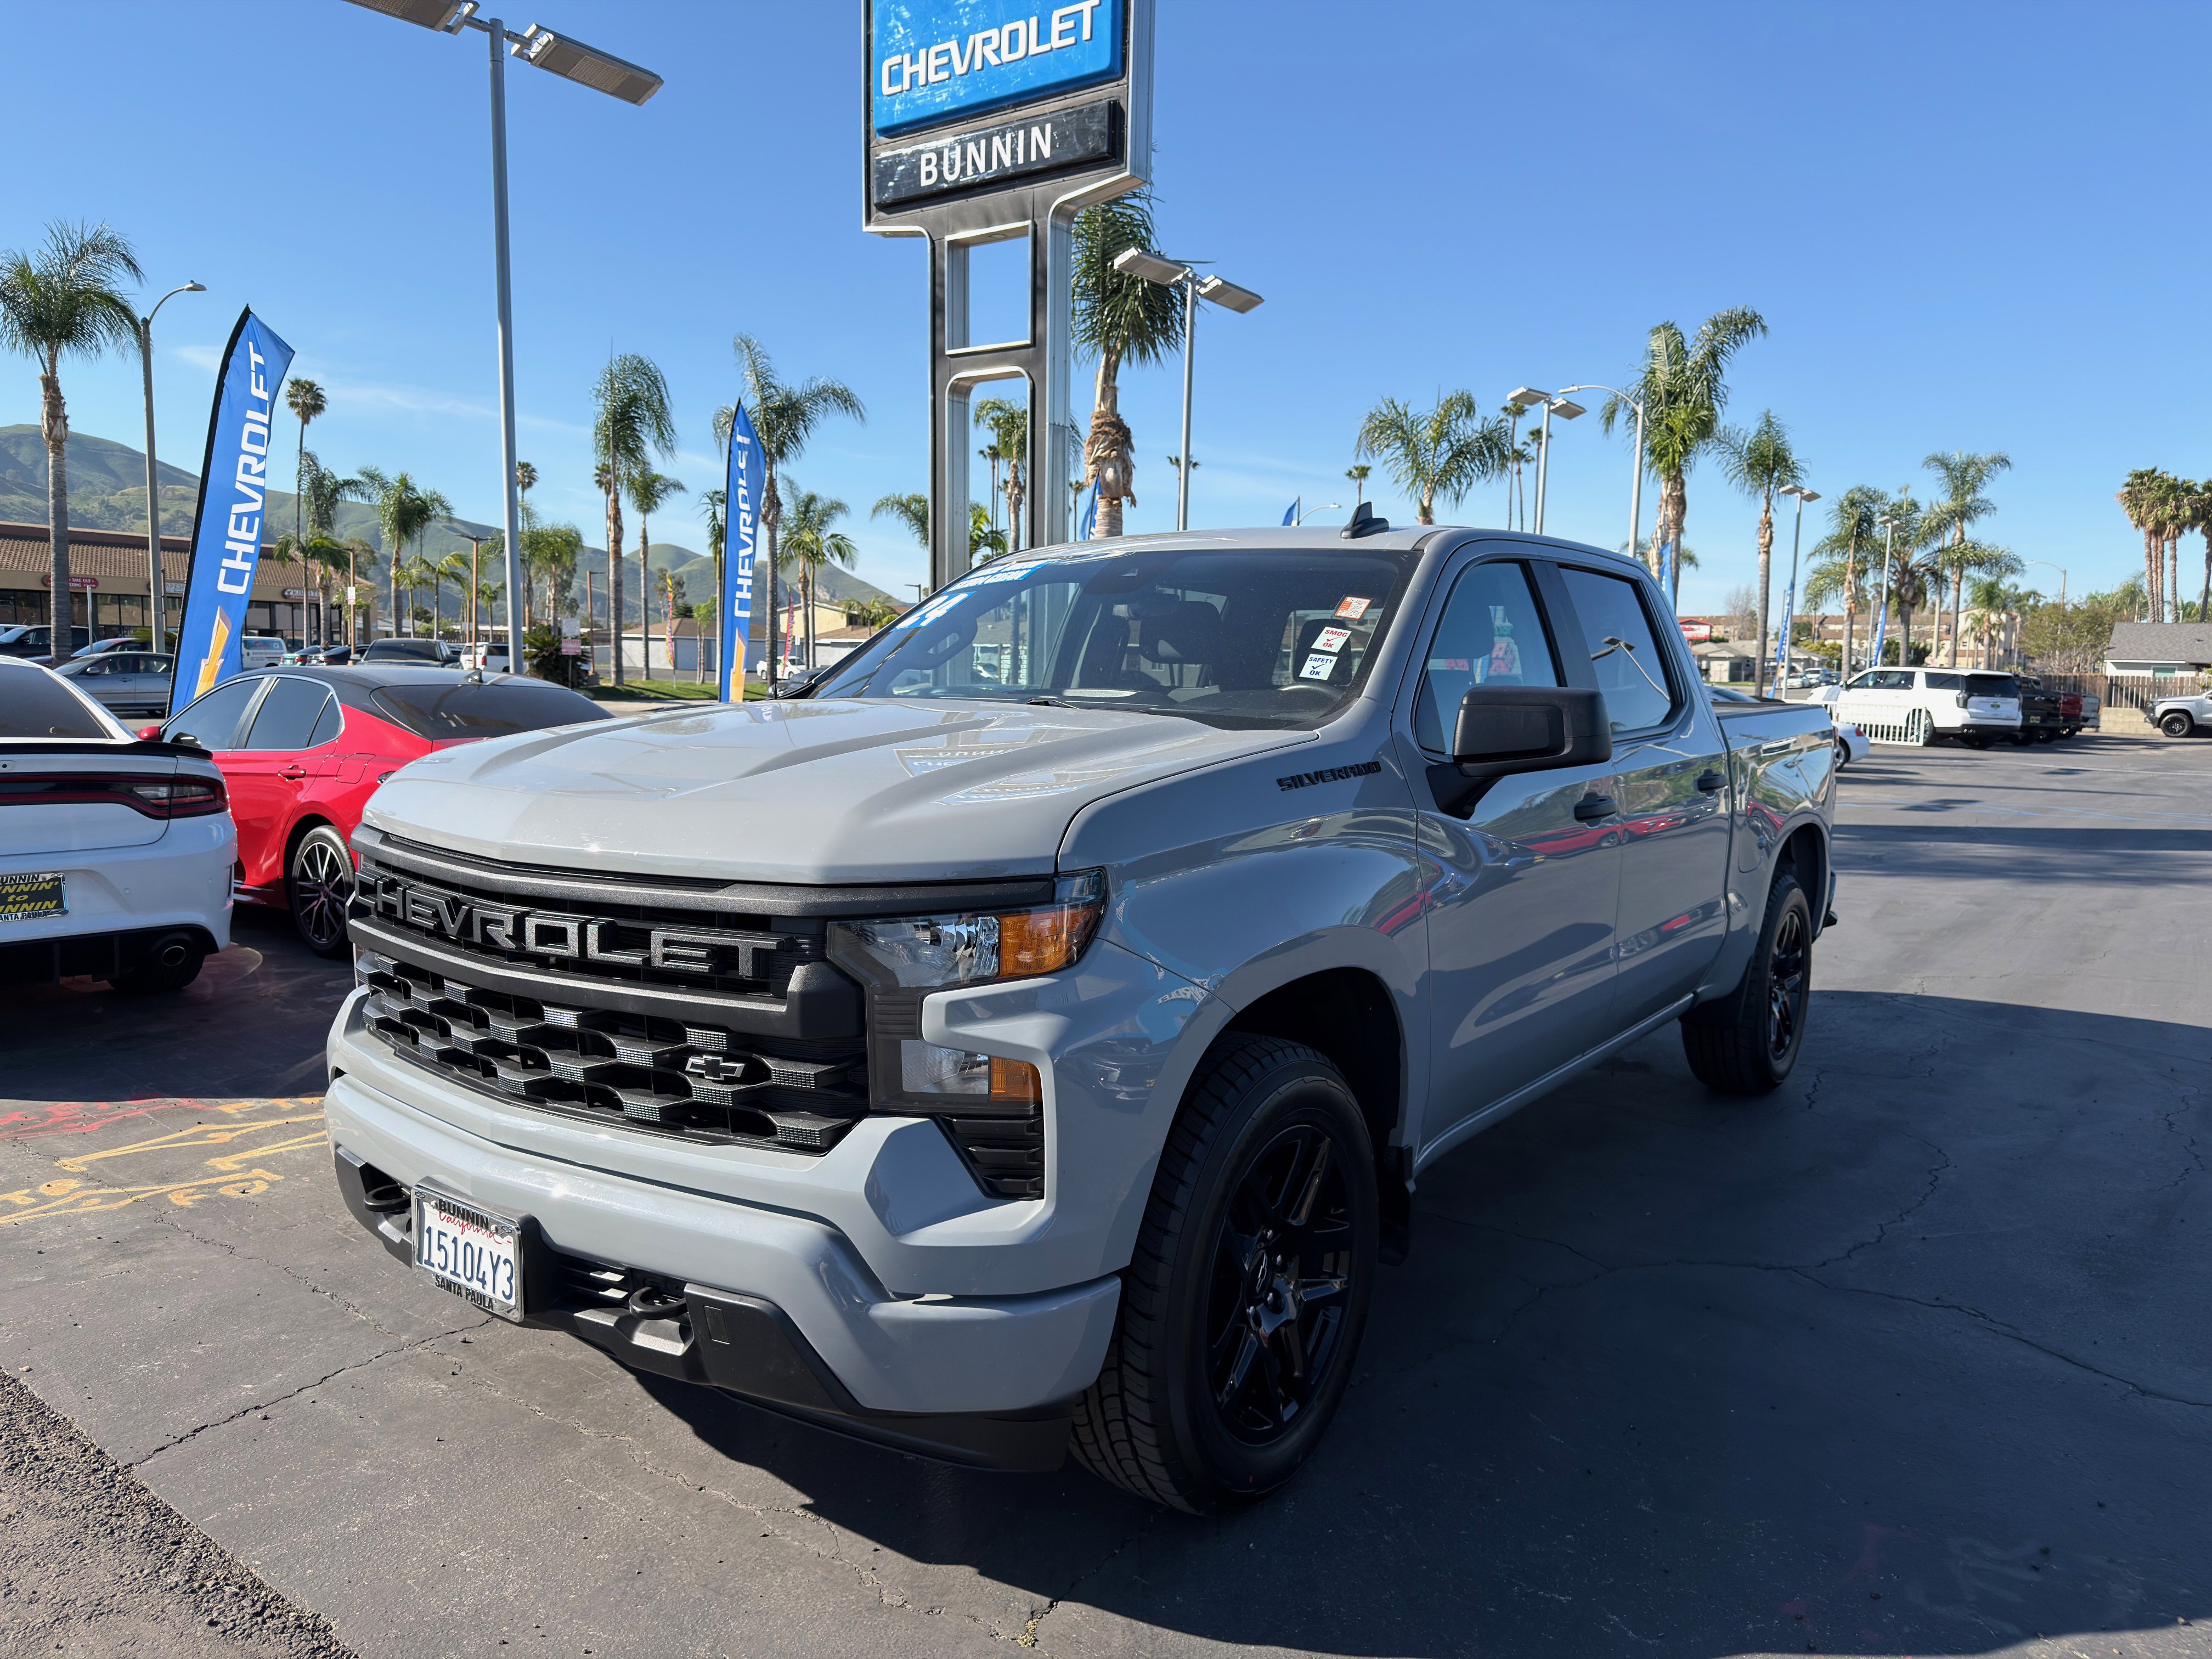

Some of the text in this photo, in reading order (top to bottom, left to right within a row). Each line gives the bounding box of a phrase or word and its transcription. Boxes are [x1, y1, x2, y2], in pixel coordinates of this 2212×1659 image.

[882, 1, 1101, 95] CHEVROLET
[919, 123, 1052, 187] BUNNIN
[217, 341, 269, 594] CHEVROLET
[734, 426, 754, 618] CHEVROLET
[1324, 629, 1348, 637] SMOG
[1276, 761, 1381, 792] SILVERADO
[0, 874, 40, 884] UNNIN
[0, 882, 59, 894] NNIN'
[0, 911, 48, 922] ANTA PAULA
[354, 868, 793, 978] CHEVROLET
[439, 1198, 489, 1229] BUNNIN
[439, 1211, 503, 1245] California
[424, 1226, 514, 1300] 15104Y3
[435, 1275, 494, 1310] SANTA PAULA
